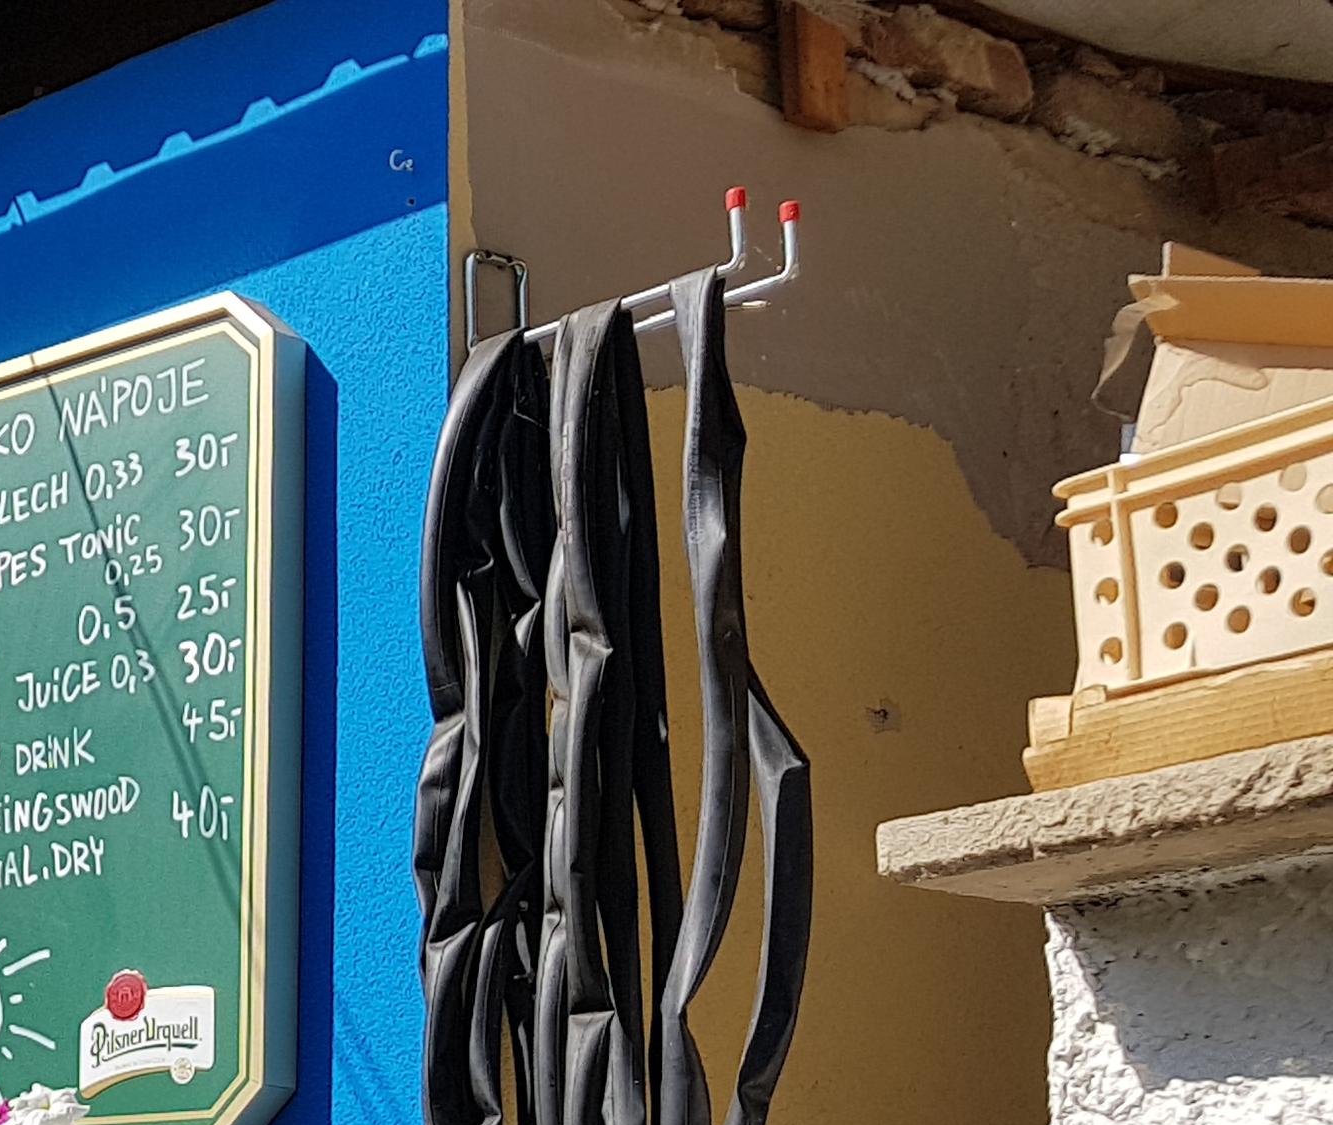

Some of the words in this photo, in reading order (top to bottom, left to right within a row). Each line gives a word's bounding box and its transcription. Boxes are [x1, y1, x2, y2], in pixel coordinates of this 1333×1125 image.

[59, 358, 210, 441] NÁPOJE
[84, 452, 143, 502] 0,33
[104, 544, 163, 587] 0,25
[110, 648, 156, 694] 0,3
[90, 1022, 145, 1069] Pilsner
[144, 1015, 199, 1052] Urquell
